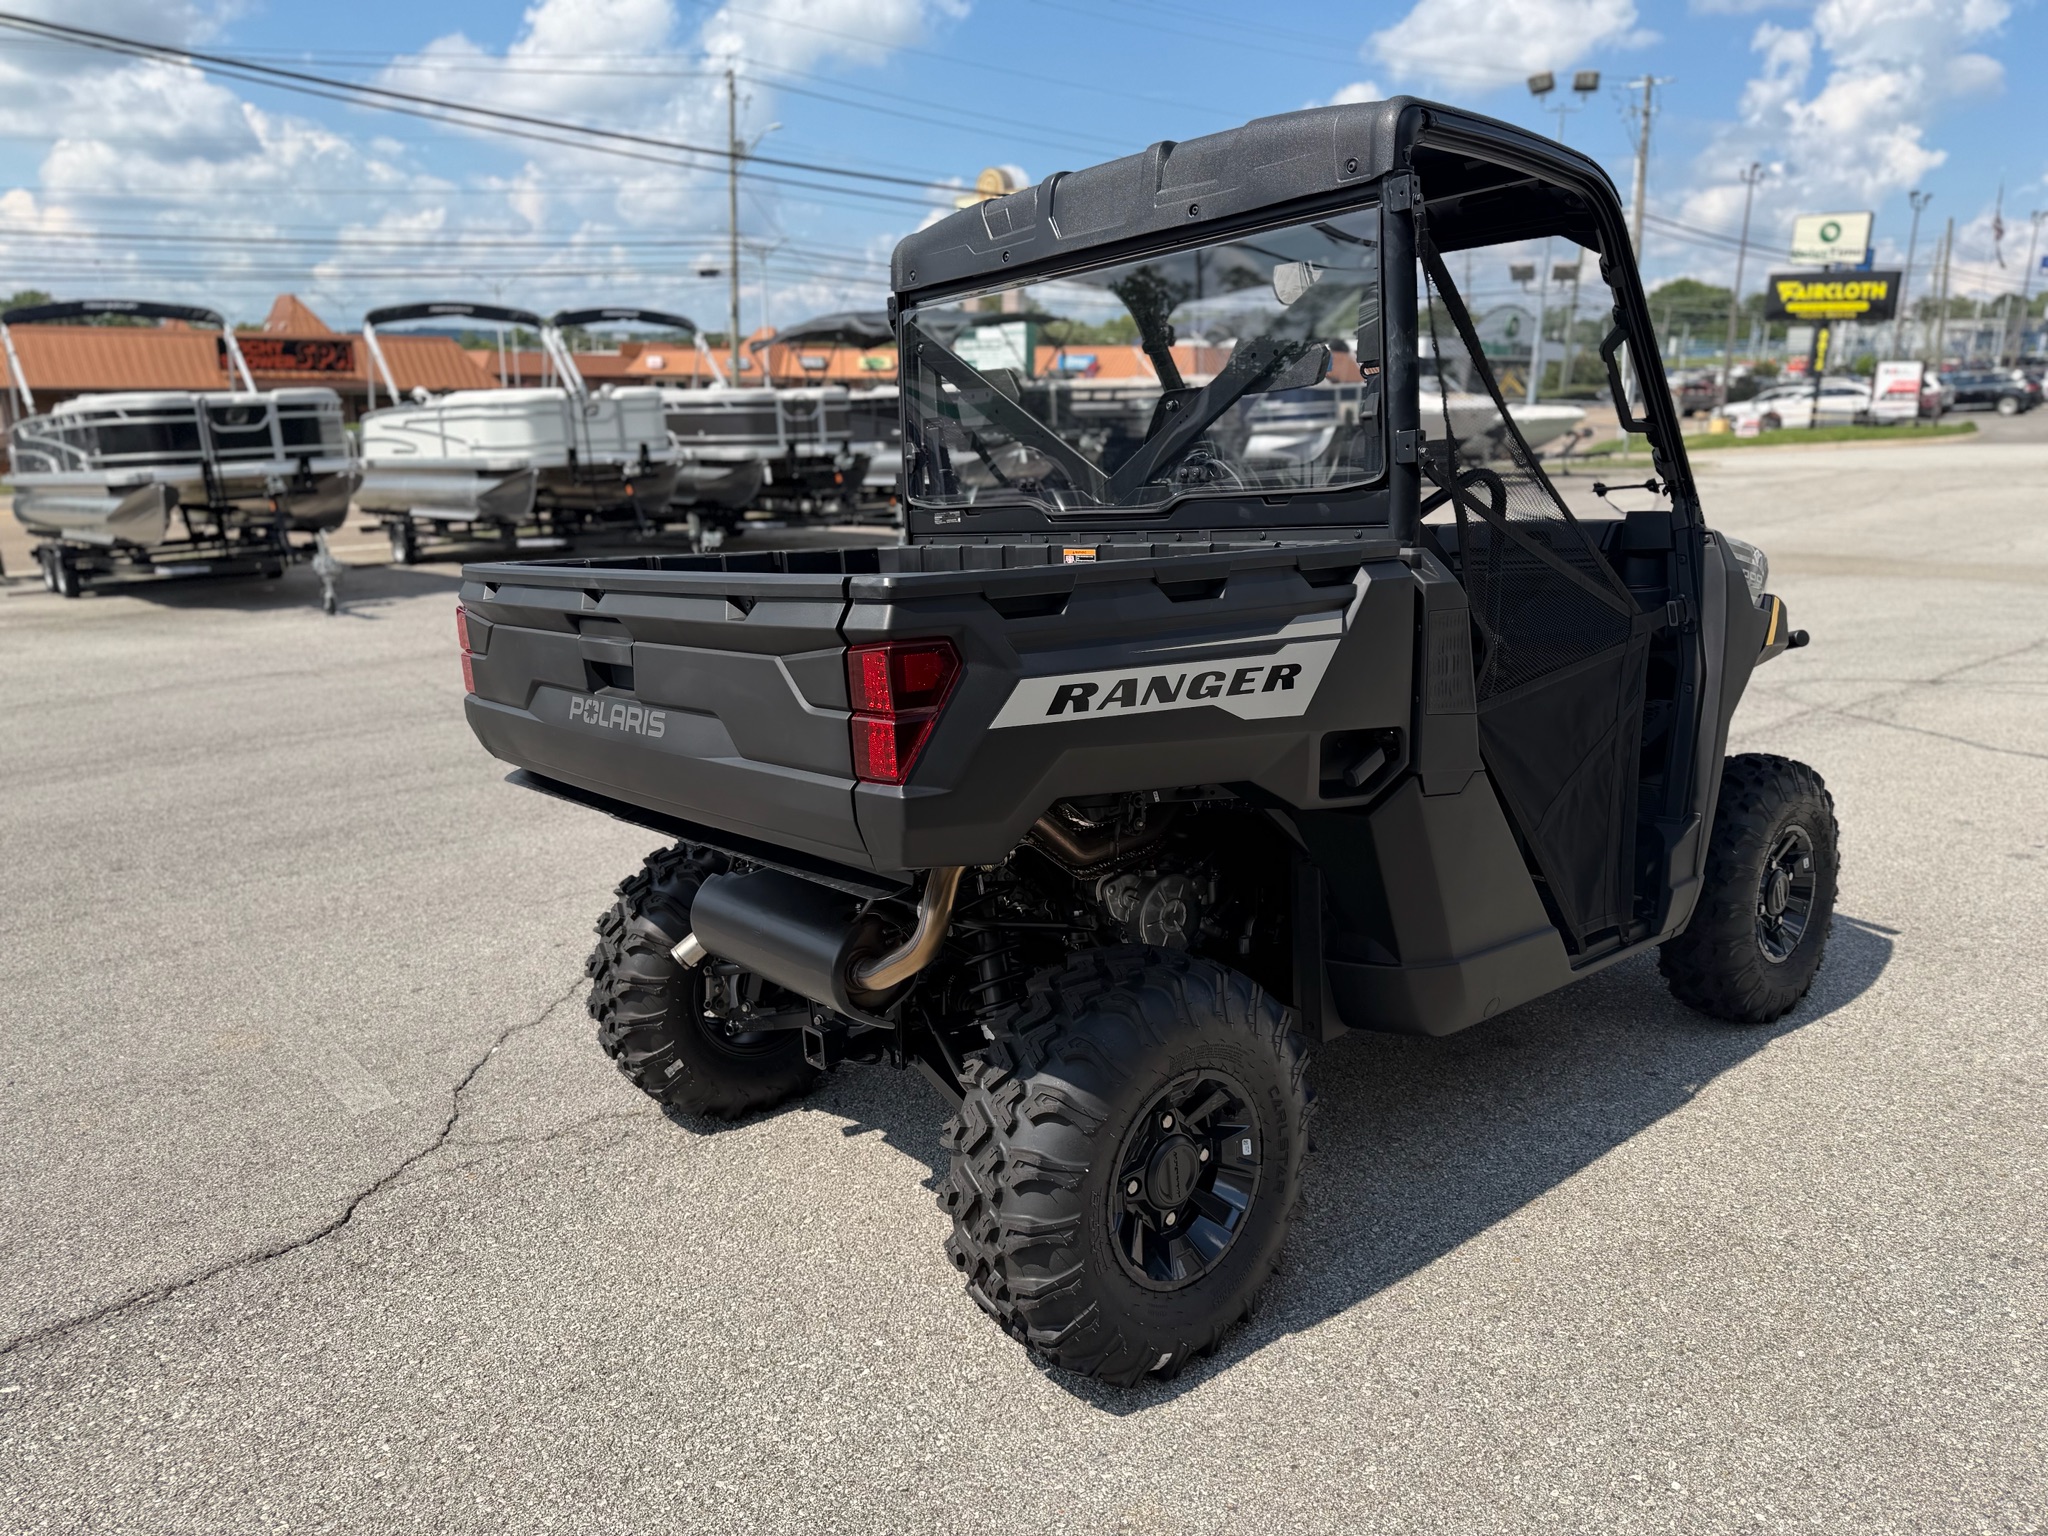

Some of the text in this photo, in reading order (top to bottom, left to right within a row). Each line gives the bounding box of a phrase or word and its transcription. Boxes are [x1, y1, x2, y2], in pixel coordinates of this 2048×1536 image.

[1776, 280, 1888, 302] FAIRCLOTH
[296, 341, 354, 369] SPA
[1045, 663, 1302, 716] RANGER
[569, 696, 665, 738] POLARIS
[1268, 1085, 1290, 1194] CARLSTAR
